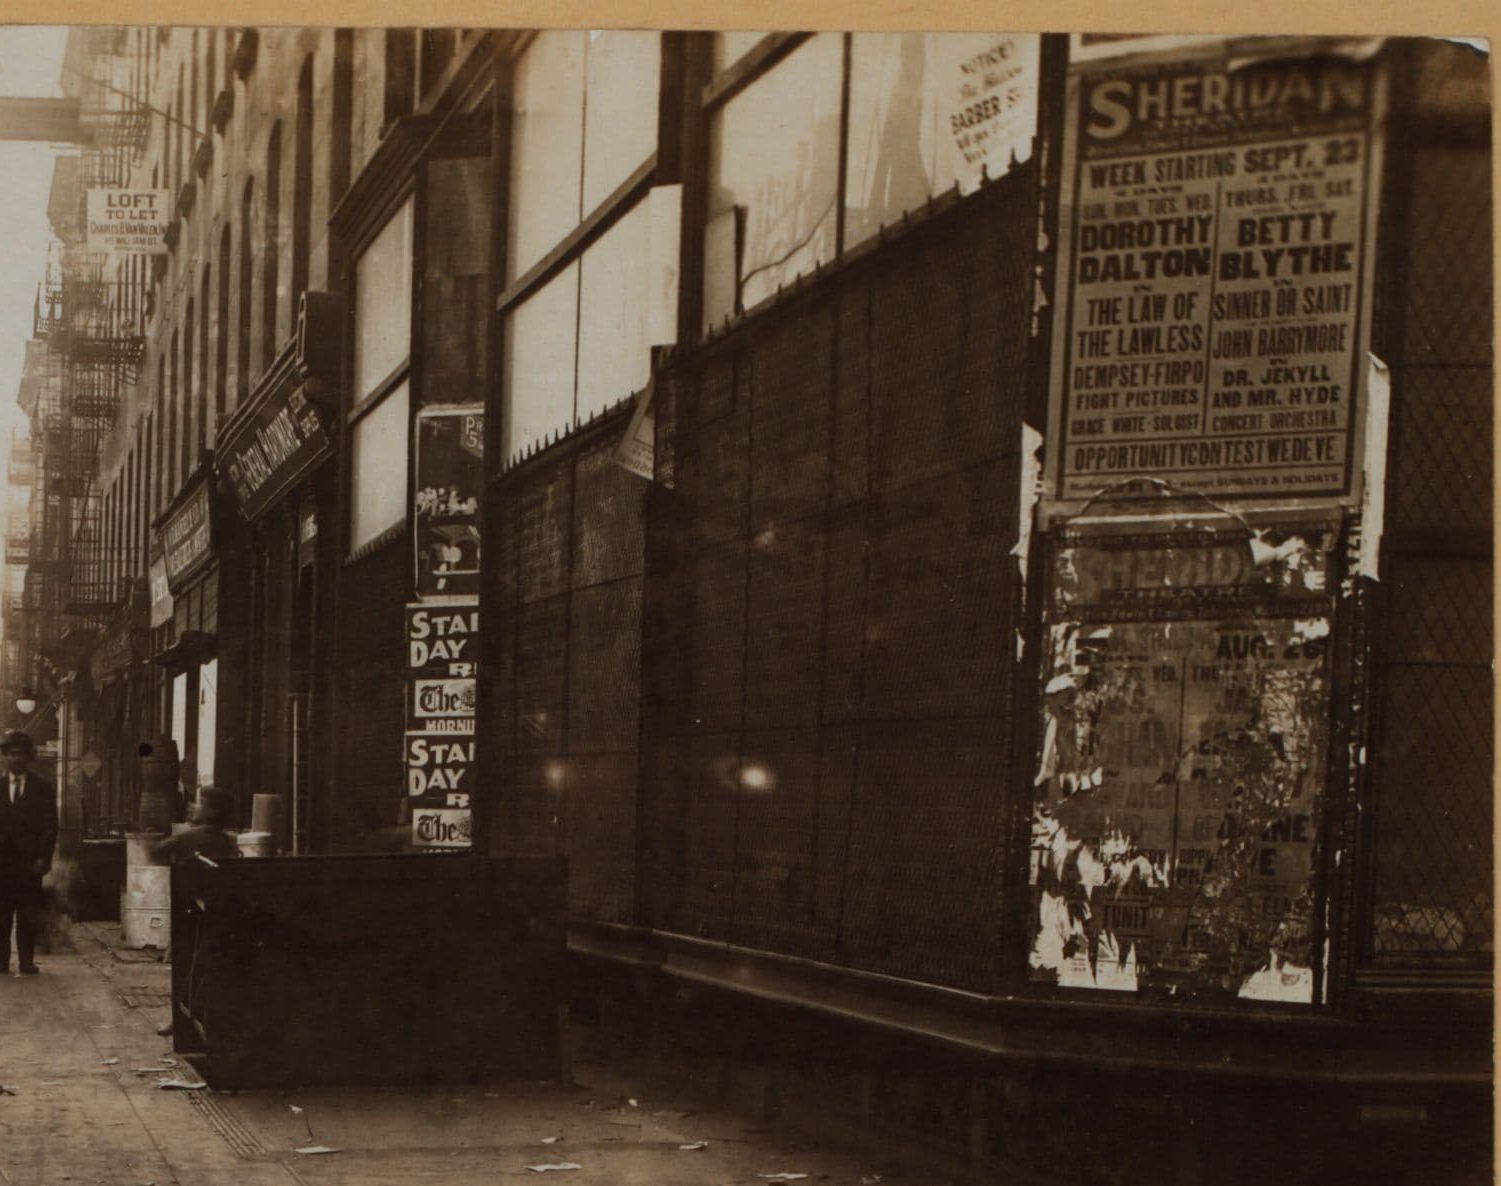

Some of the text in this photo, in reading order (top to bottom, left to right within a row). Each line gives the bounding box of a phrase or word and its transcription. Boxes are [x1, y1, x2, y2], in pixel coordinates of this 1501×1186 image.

[949, 95, 1001, 136] BARBER
[1086, 70, 1364, 138] SHERIDAN
[1090, 160, 1146, 189] WEEK
[1155, 152, 1236, 184] STARTING
[1243, 142, 1315, 173] SEPT.
[1325, 138, 1360, 165] 23
[105, 210, 158, 220] TO LET
[107, 193, 157, 208] LOFT
[1081, 214, 1213, 253] DOROTHY
[1238, 210, 1337, 247] BETTY
[1079, 248, 1211, 284] DALTON
[1220, 241, 1353, 281] BLYTHE
[1087, 291, 1200, 327] THE LAW OF
[1213, 283, 1353, 321] SINNER OR SAINT
[1077, 324, 1203, 358] THE LAWLESS
[1213, 323, 1348, 360] JOHN BARRYMORE
[1074, 360, 1204, 390] DEMPSEY-FIRPO
[1223, 365, 1331, 387] DR. JEKYLL
[1076, 389, 1199, 410] FIGHT PICTURES
[1212, 385, 1341, 408] AND MR. HYDE
[1071, 413, 1200, 435] GRACE WHITE SOLOIST
[1212, 409, 1338, 432] CONCERT ORCHESTRA
[1075, 442, 1187, 471] OPPORTUNITY
[1187, 440, 1266, 466] CONTEST
[1217, 474, 1269, 488] SUNDAYS
[1282, 472, 1339, 485] HOLIDAYS
[410, 639, 468, 668] DAY
[1217, 634, 1276, 661] AUG.
[418, 683, 460, 714] The
[408, 768, 466, 797] DAY
[416, 811, 458, 842] The
